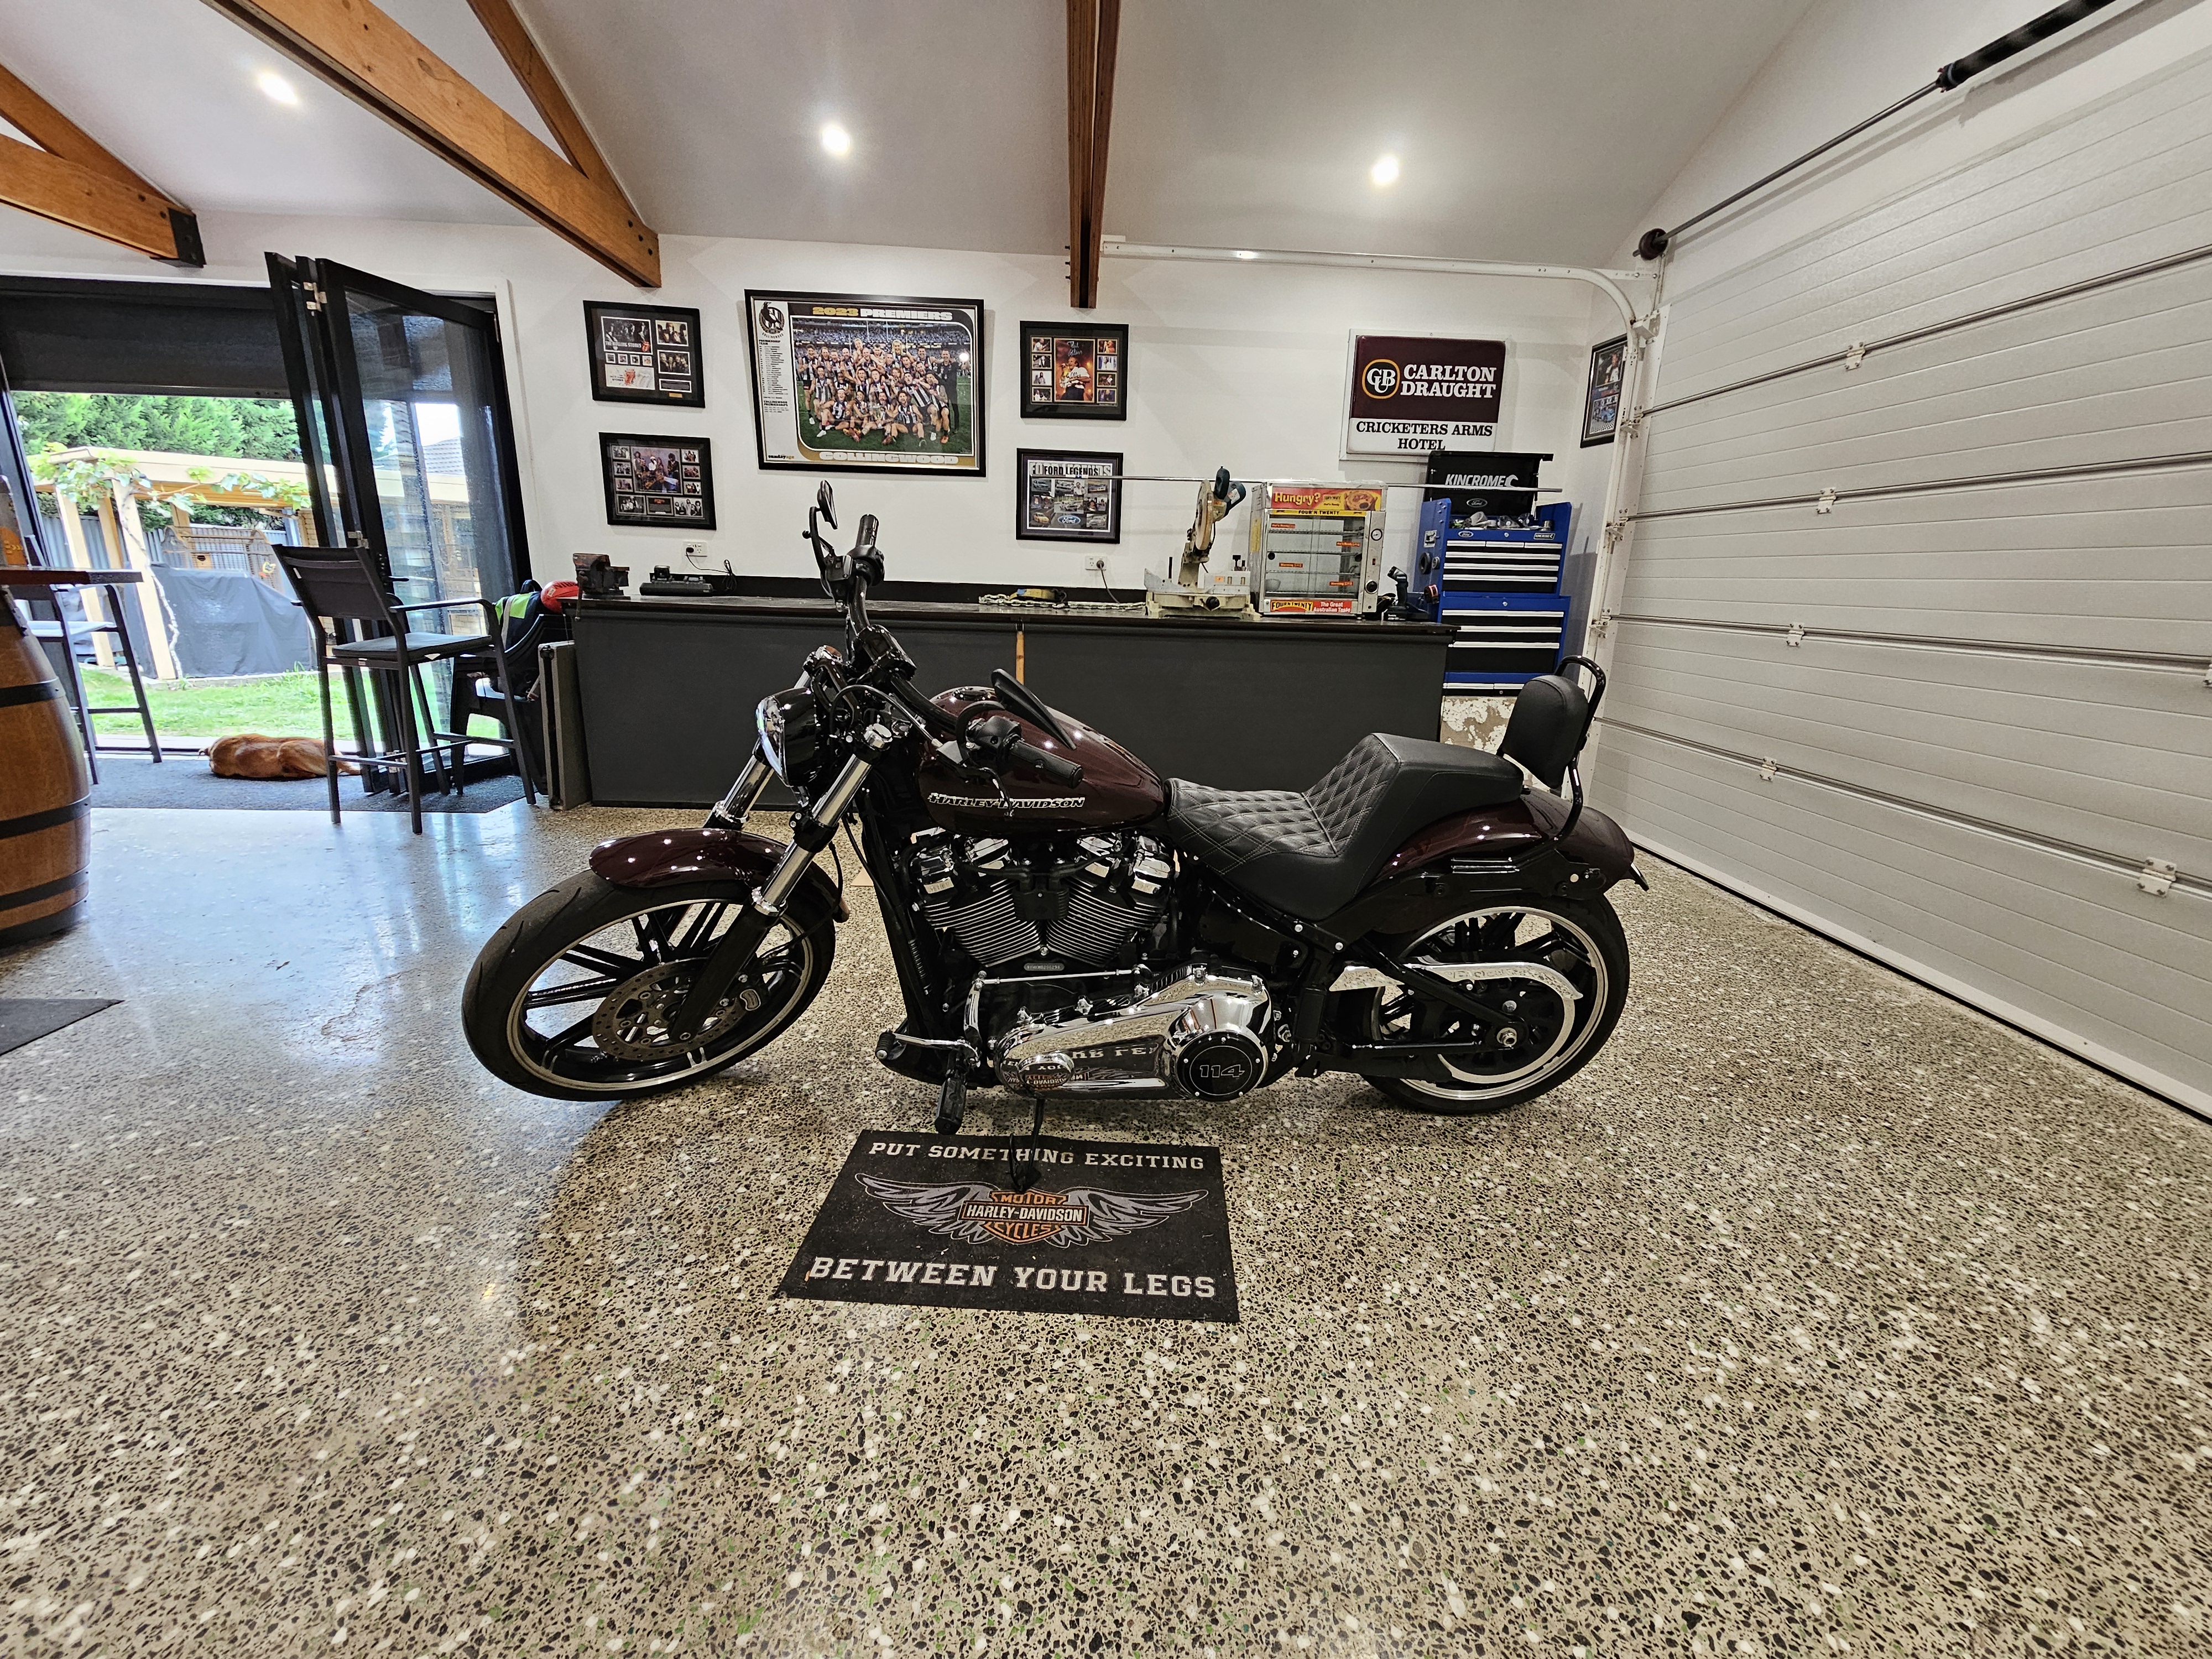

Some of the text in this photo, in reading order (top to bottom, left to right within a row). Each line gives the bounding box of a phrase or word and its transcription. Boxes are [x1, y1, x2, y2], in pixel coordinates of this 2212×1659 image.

[812, 307, 953, 321] 2023 PREMIERS
[1404, 364, 1496, 382] CARLTON
[1400, 381, 1496, 398] DRAUGHT
[1356, 421, 1493, 436] CRICKETERS ARMS
[1397, 438, 1446, 451] HOTEL
[819, 451, 958, 464] COLLINGWOOD
[1445, 474, 1506, 487] KINCROME
[1274, 492, 1321, 506] Hungry?
[927, 792, 1085, 808] HARLEY-DAVIDSON
[1199, 1064, 1245, 1078] 114
[869, 1142, 1204, 1170] PUT SOMETHING EXCITING
[1000, 1193, 1057, 1205] MOTOR
[967, 1204, 1082, 1222] HARLEY-DAVIDSON
[994, 1222, 1051, 1239] CYCLES
[808, 1256, 1215, 1298] BETWEEN YOUR LEGS
